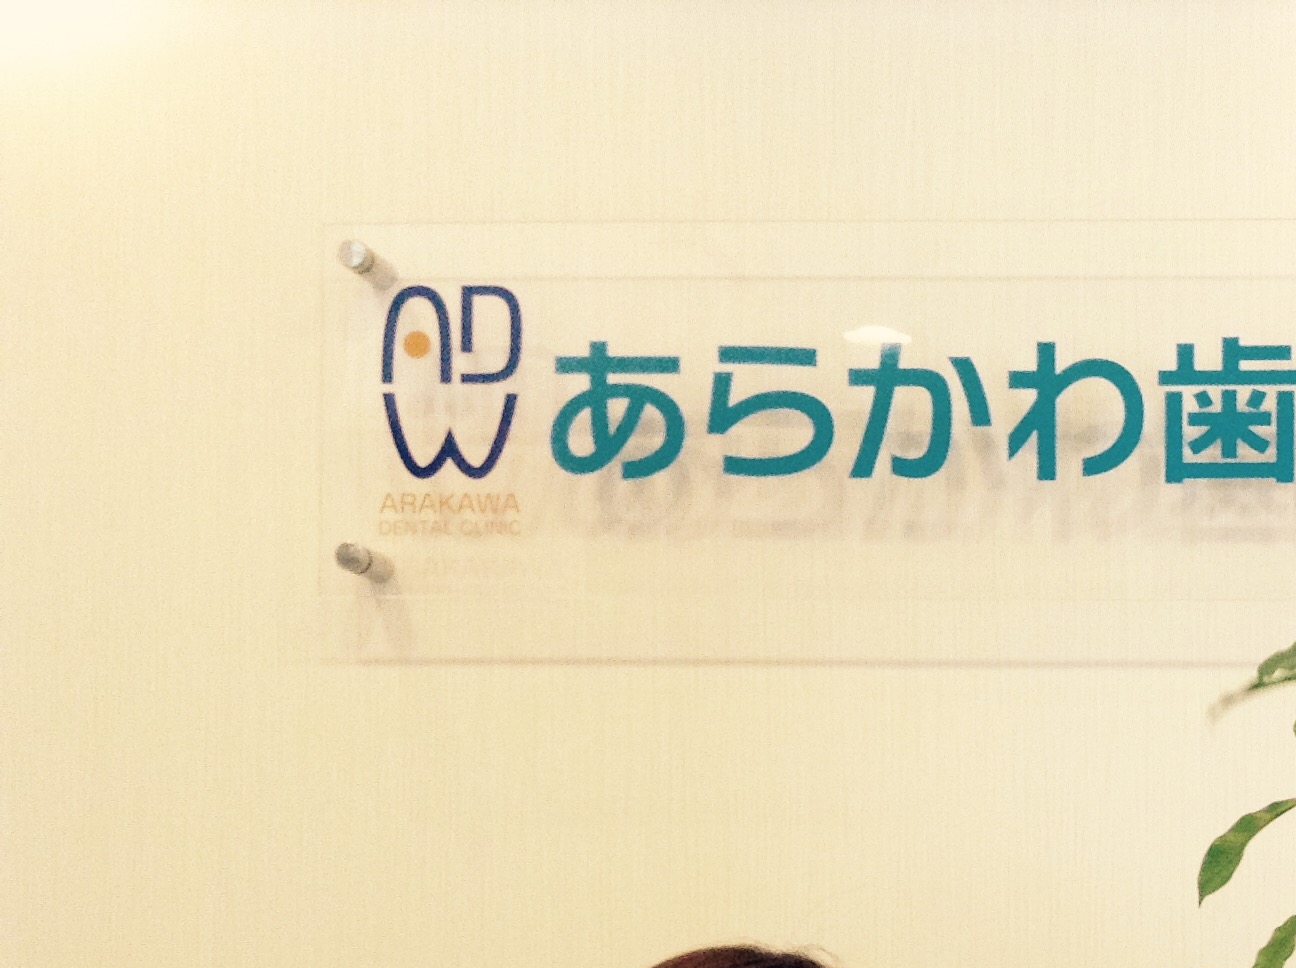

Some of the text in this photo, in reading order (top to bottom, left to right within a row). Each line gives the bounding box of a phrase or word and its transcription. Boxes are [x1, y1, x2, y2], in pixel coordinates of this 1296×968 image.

[379, 492, 521, 514] ARAKAWA
[379, 519, 522, 537] DENTAL CLINIC
